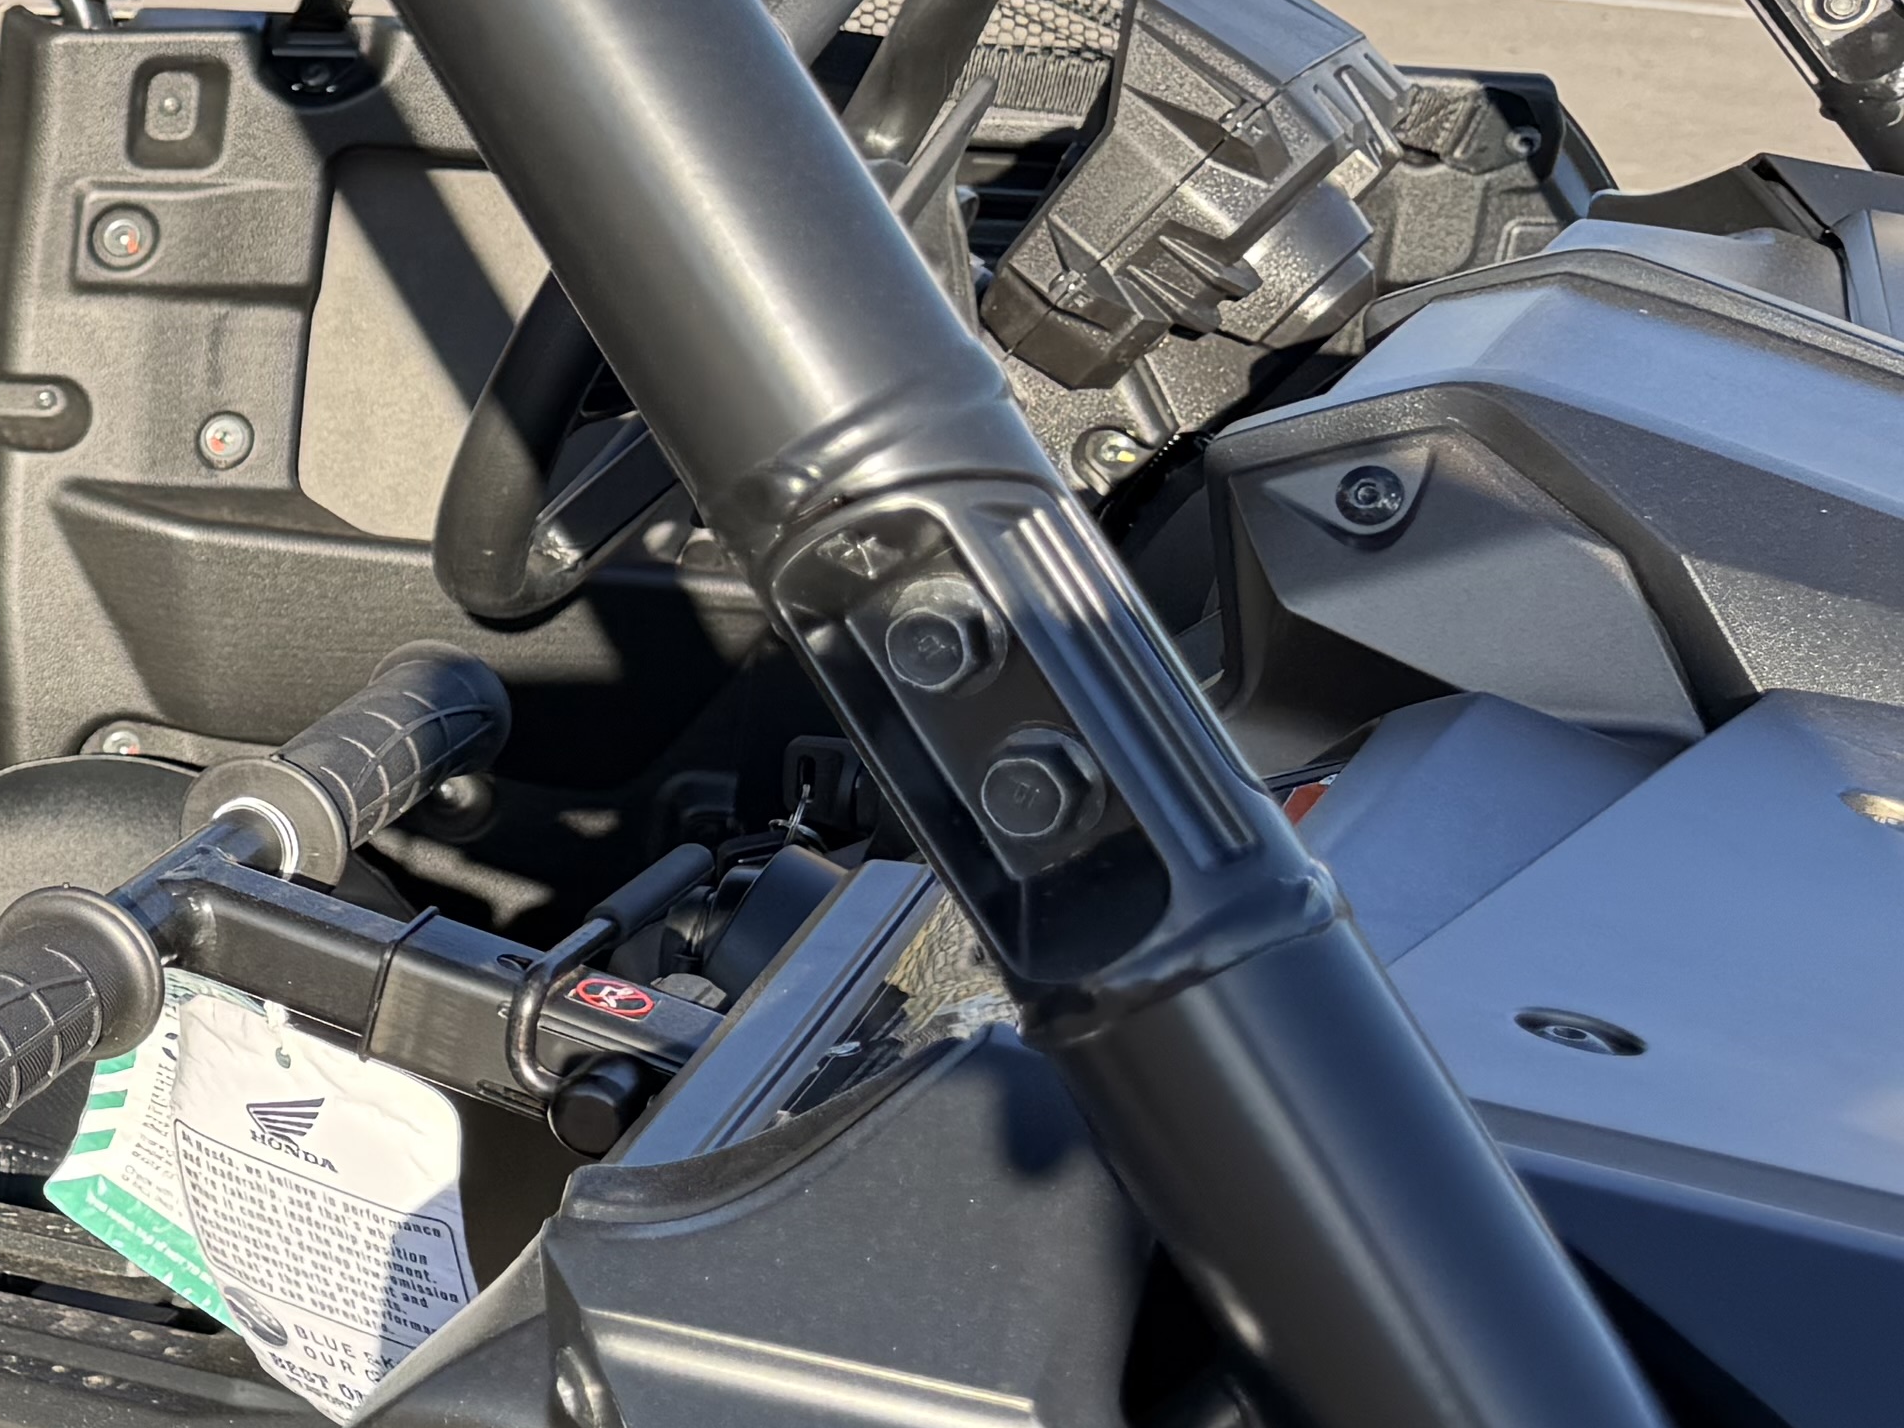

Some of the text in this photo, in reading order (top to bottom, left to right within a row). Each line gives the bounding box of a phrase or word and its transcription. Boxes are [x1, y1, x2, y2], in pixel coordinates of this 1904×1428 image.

[249, 1128, 339, 1173] HONDA
[267, 1170, 317, 1200] believe
[341, 1200, 442, 1239] performance
[400, 1291, 430, 1309] and
[293, 1323, 357, 1359] BLUE
[303, 1345, 356, 1376] OUR
